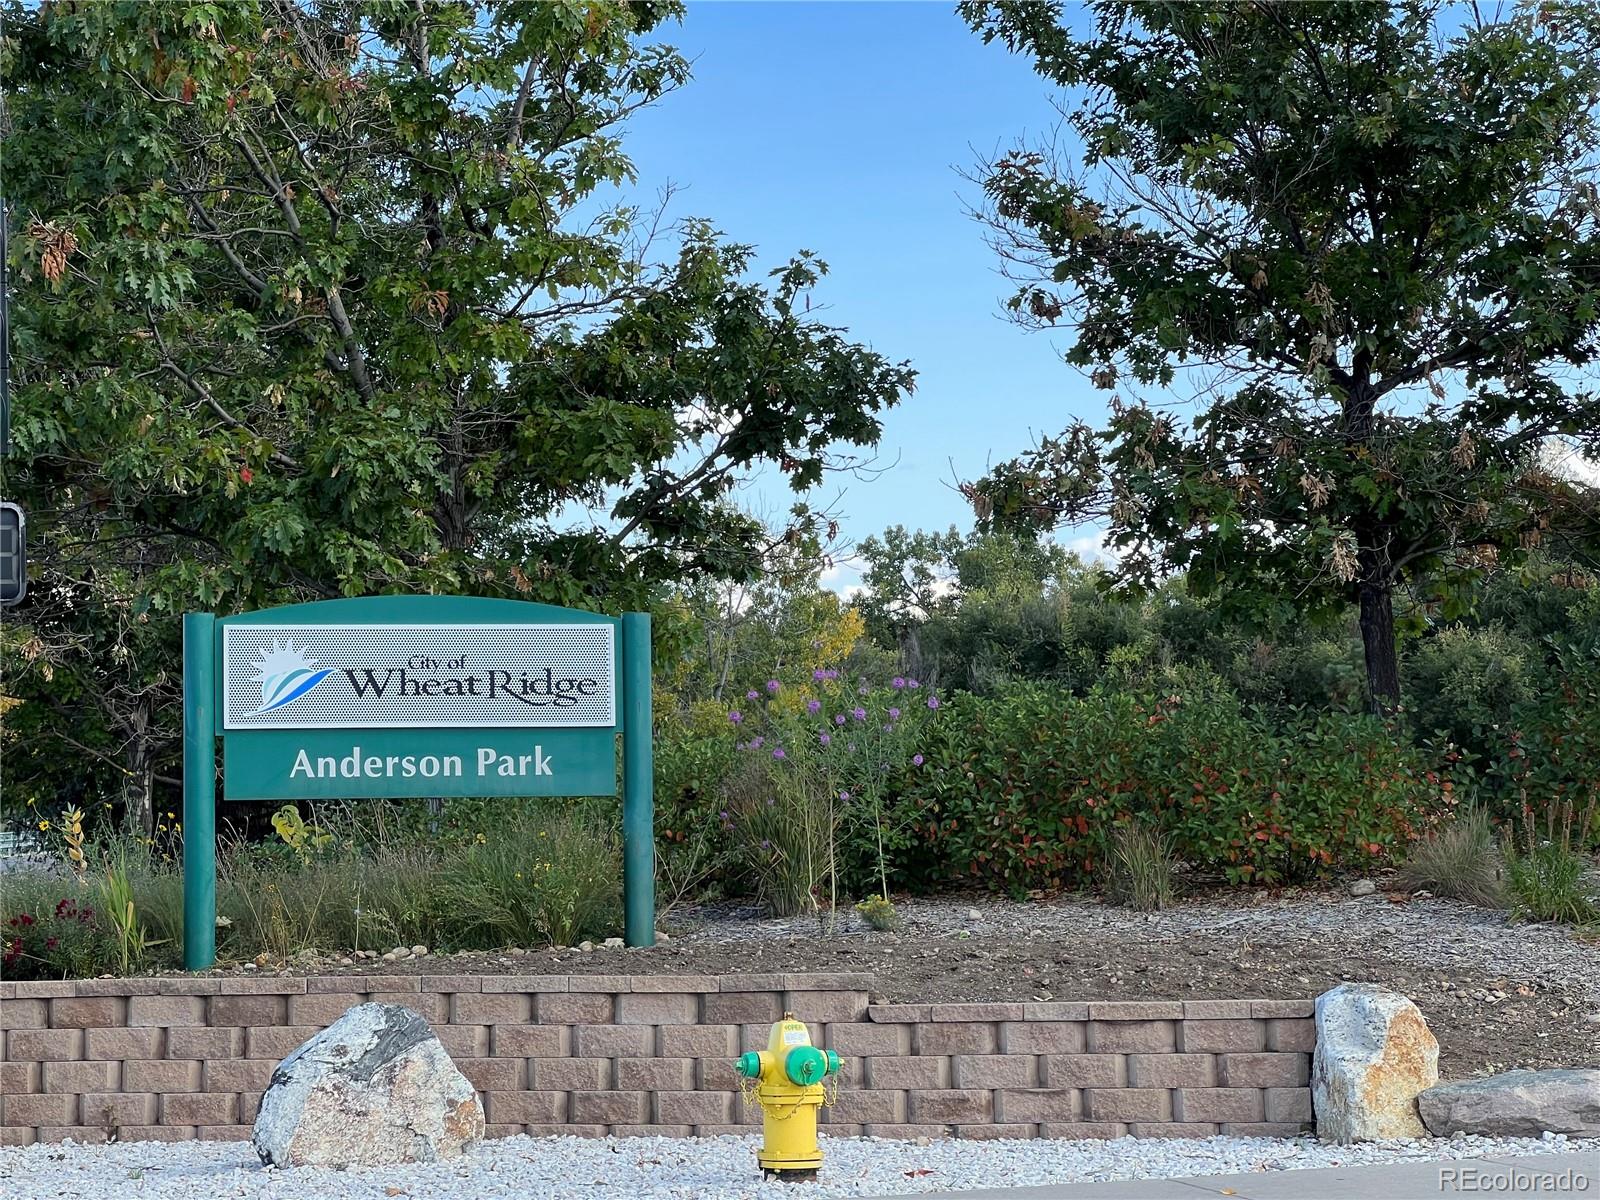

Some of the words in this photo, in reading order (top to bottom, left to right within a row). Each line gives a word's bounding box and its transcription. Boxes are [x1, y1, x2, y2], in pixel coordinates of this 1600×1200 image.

[408, 655, 442, 674] City
[448, 654, 467, 670] of
[343, 667, 482, 698] Wheat
[488, 667, 598, 706] Ridge
[289, 746, 462, 778] Anderson
[477, 745, 553, 776] Park
